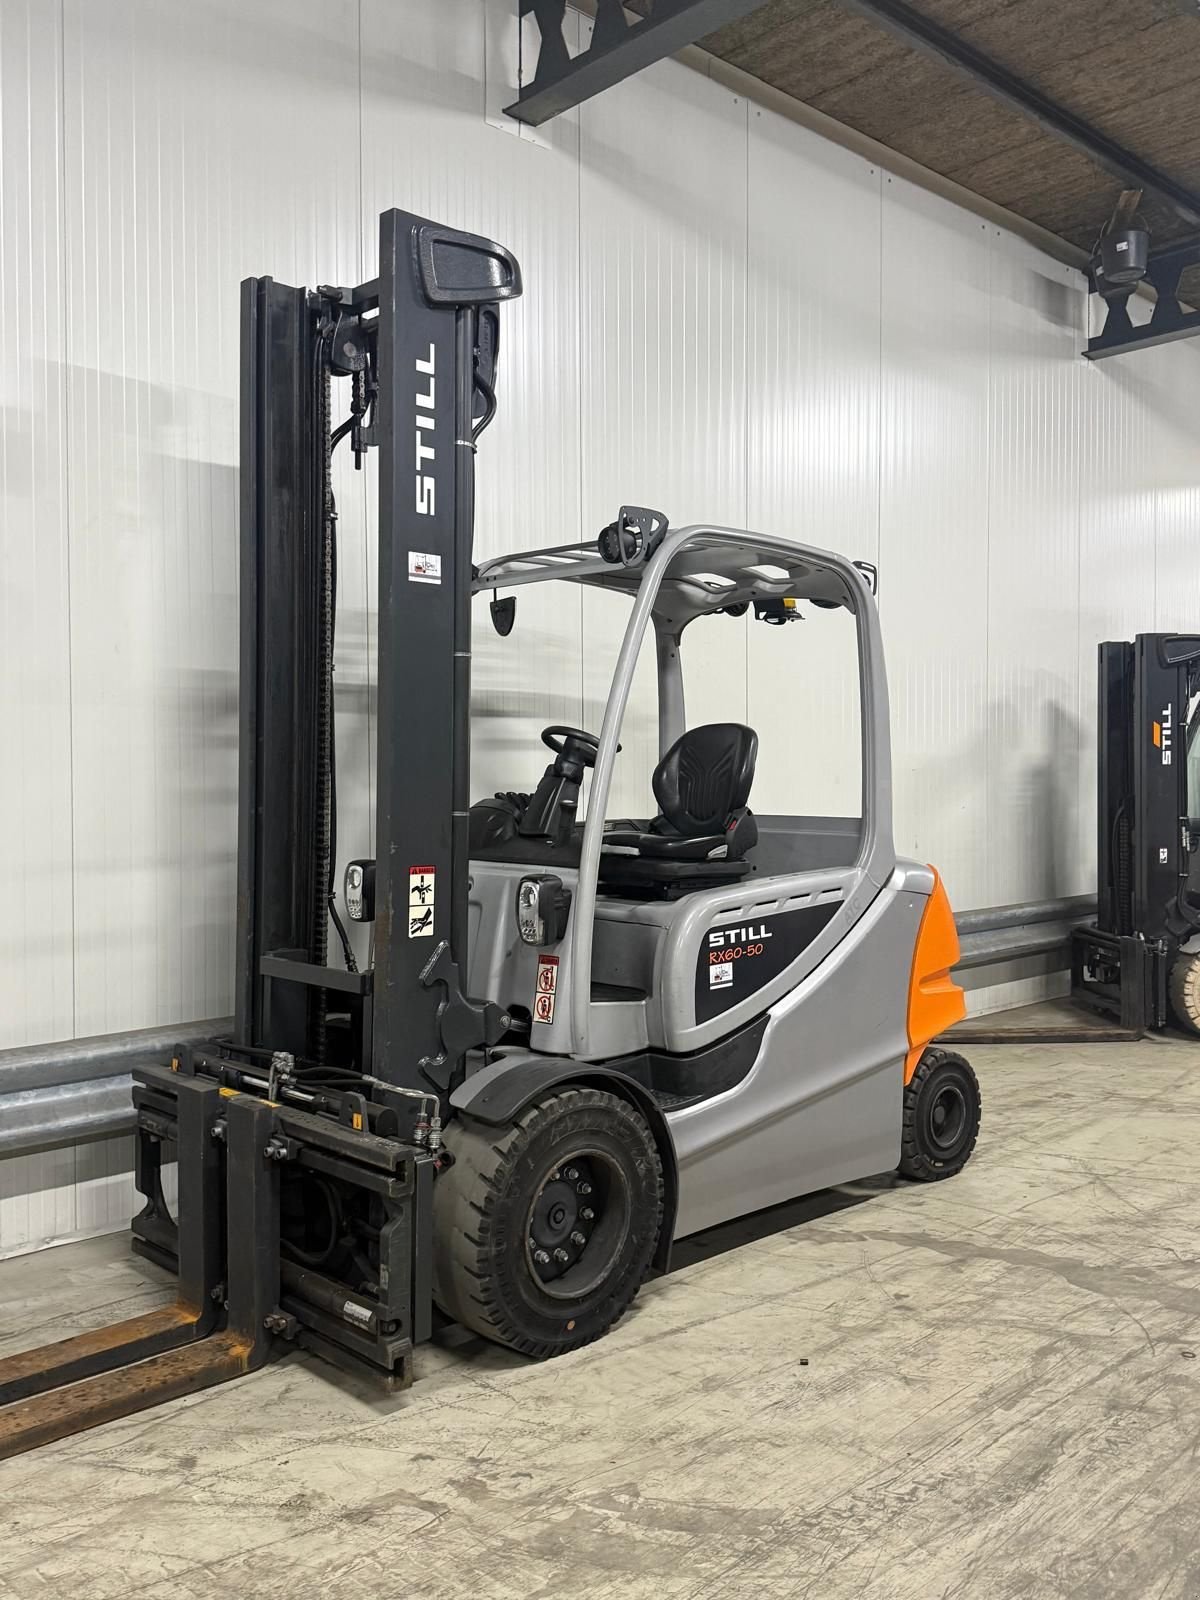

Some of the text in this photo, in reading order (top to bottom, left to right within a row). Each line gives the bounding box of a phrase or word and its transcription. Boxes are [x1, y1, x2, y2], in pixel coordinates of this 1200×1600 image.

[415, 343, 435, 516] STILL
[1162, 703, 1172, 765] STILL
[709, 925, 772, 947] STILL
[709, 943, 763, 964] RX60-50
